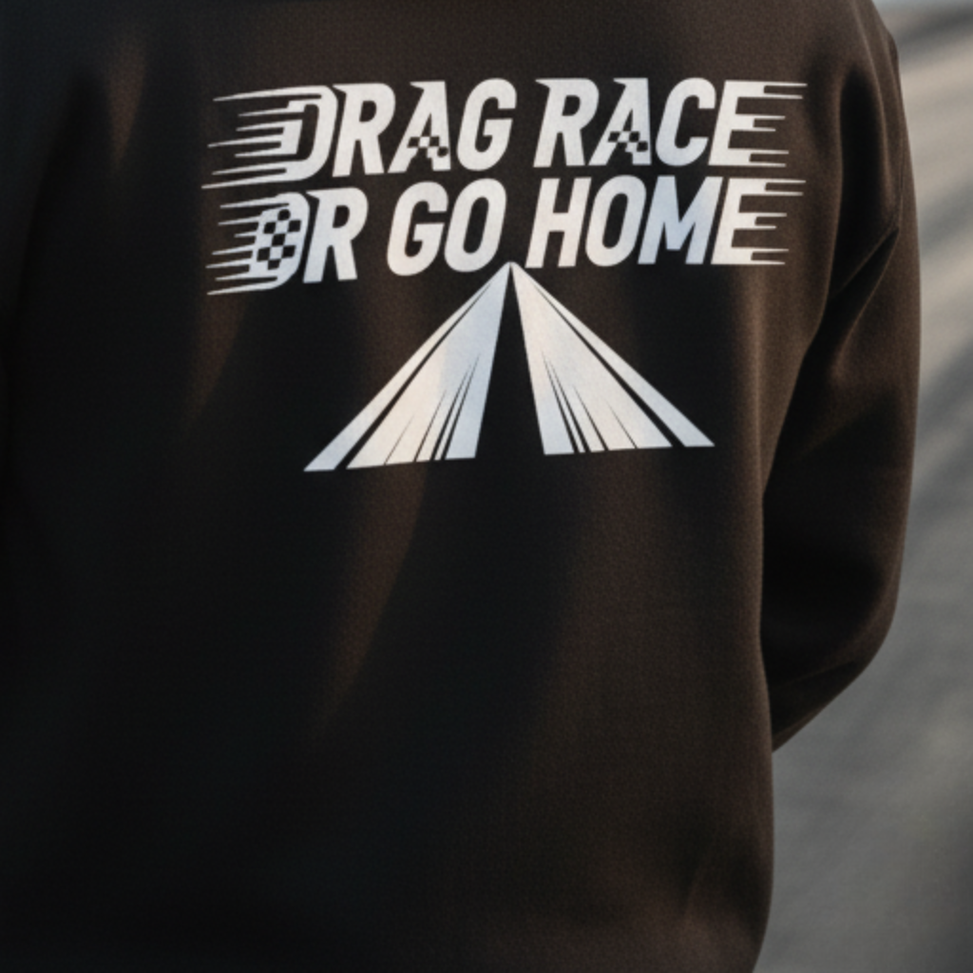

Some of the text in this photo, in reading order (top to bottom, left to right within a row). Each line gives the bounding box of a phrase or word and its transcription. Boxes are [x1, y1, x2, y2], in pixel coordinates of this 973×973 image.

[217, 77, 802, 188] DRAG RACE
[212, 175, 802, 294] OR GO HOME
